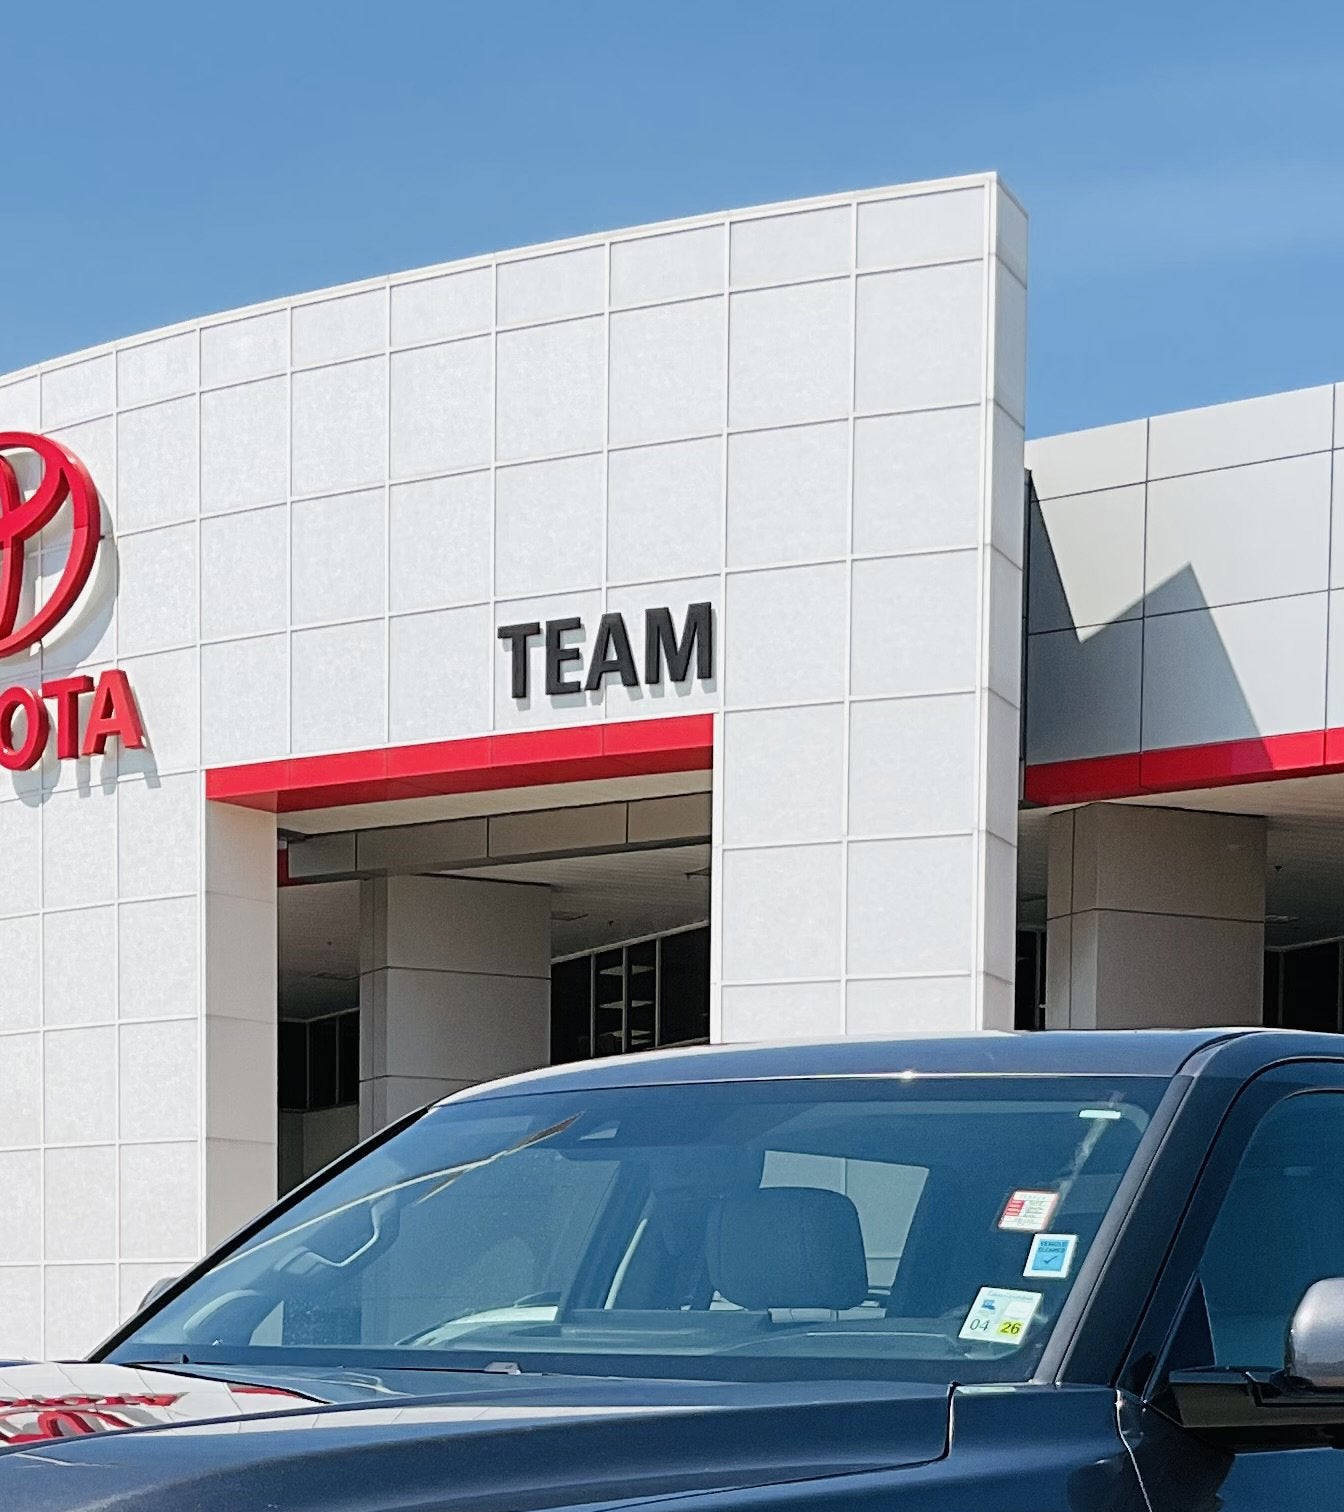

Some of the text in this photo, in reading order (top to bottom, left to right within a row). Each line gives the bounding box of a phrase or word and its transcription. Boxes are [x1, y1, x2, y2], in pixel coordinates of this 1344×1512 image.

[497, 601, 715, 700] TEAM
[969, 1318, 1023, 1335] 04 26
